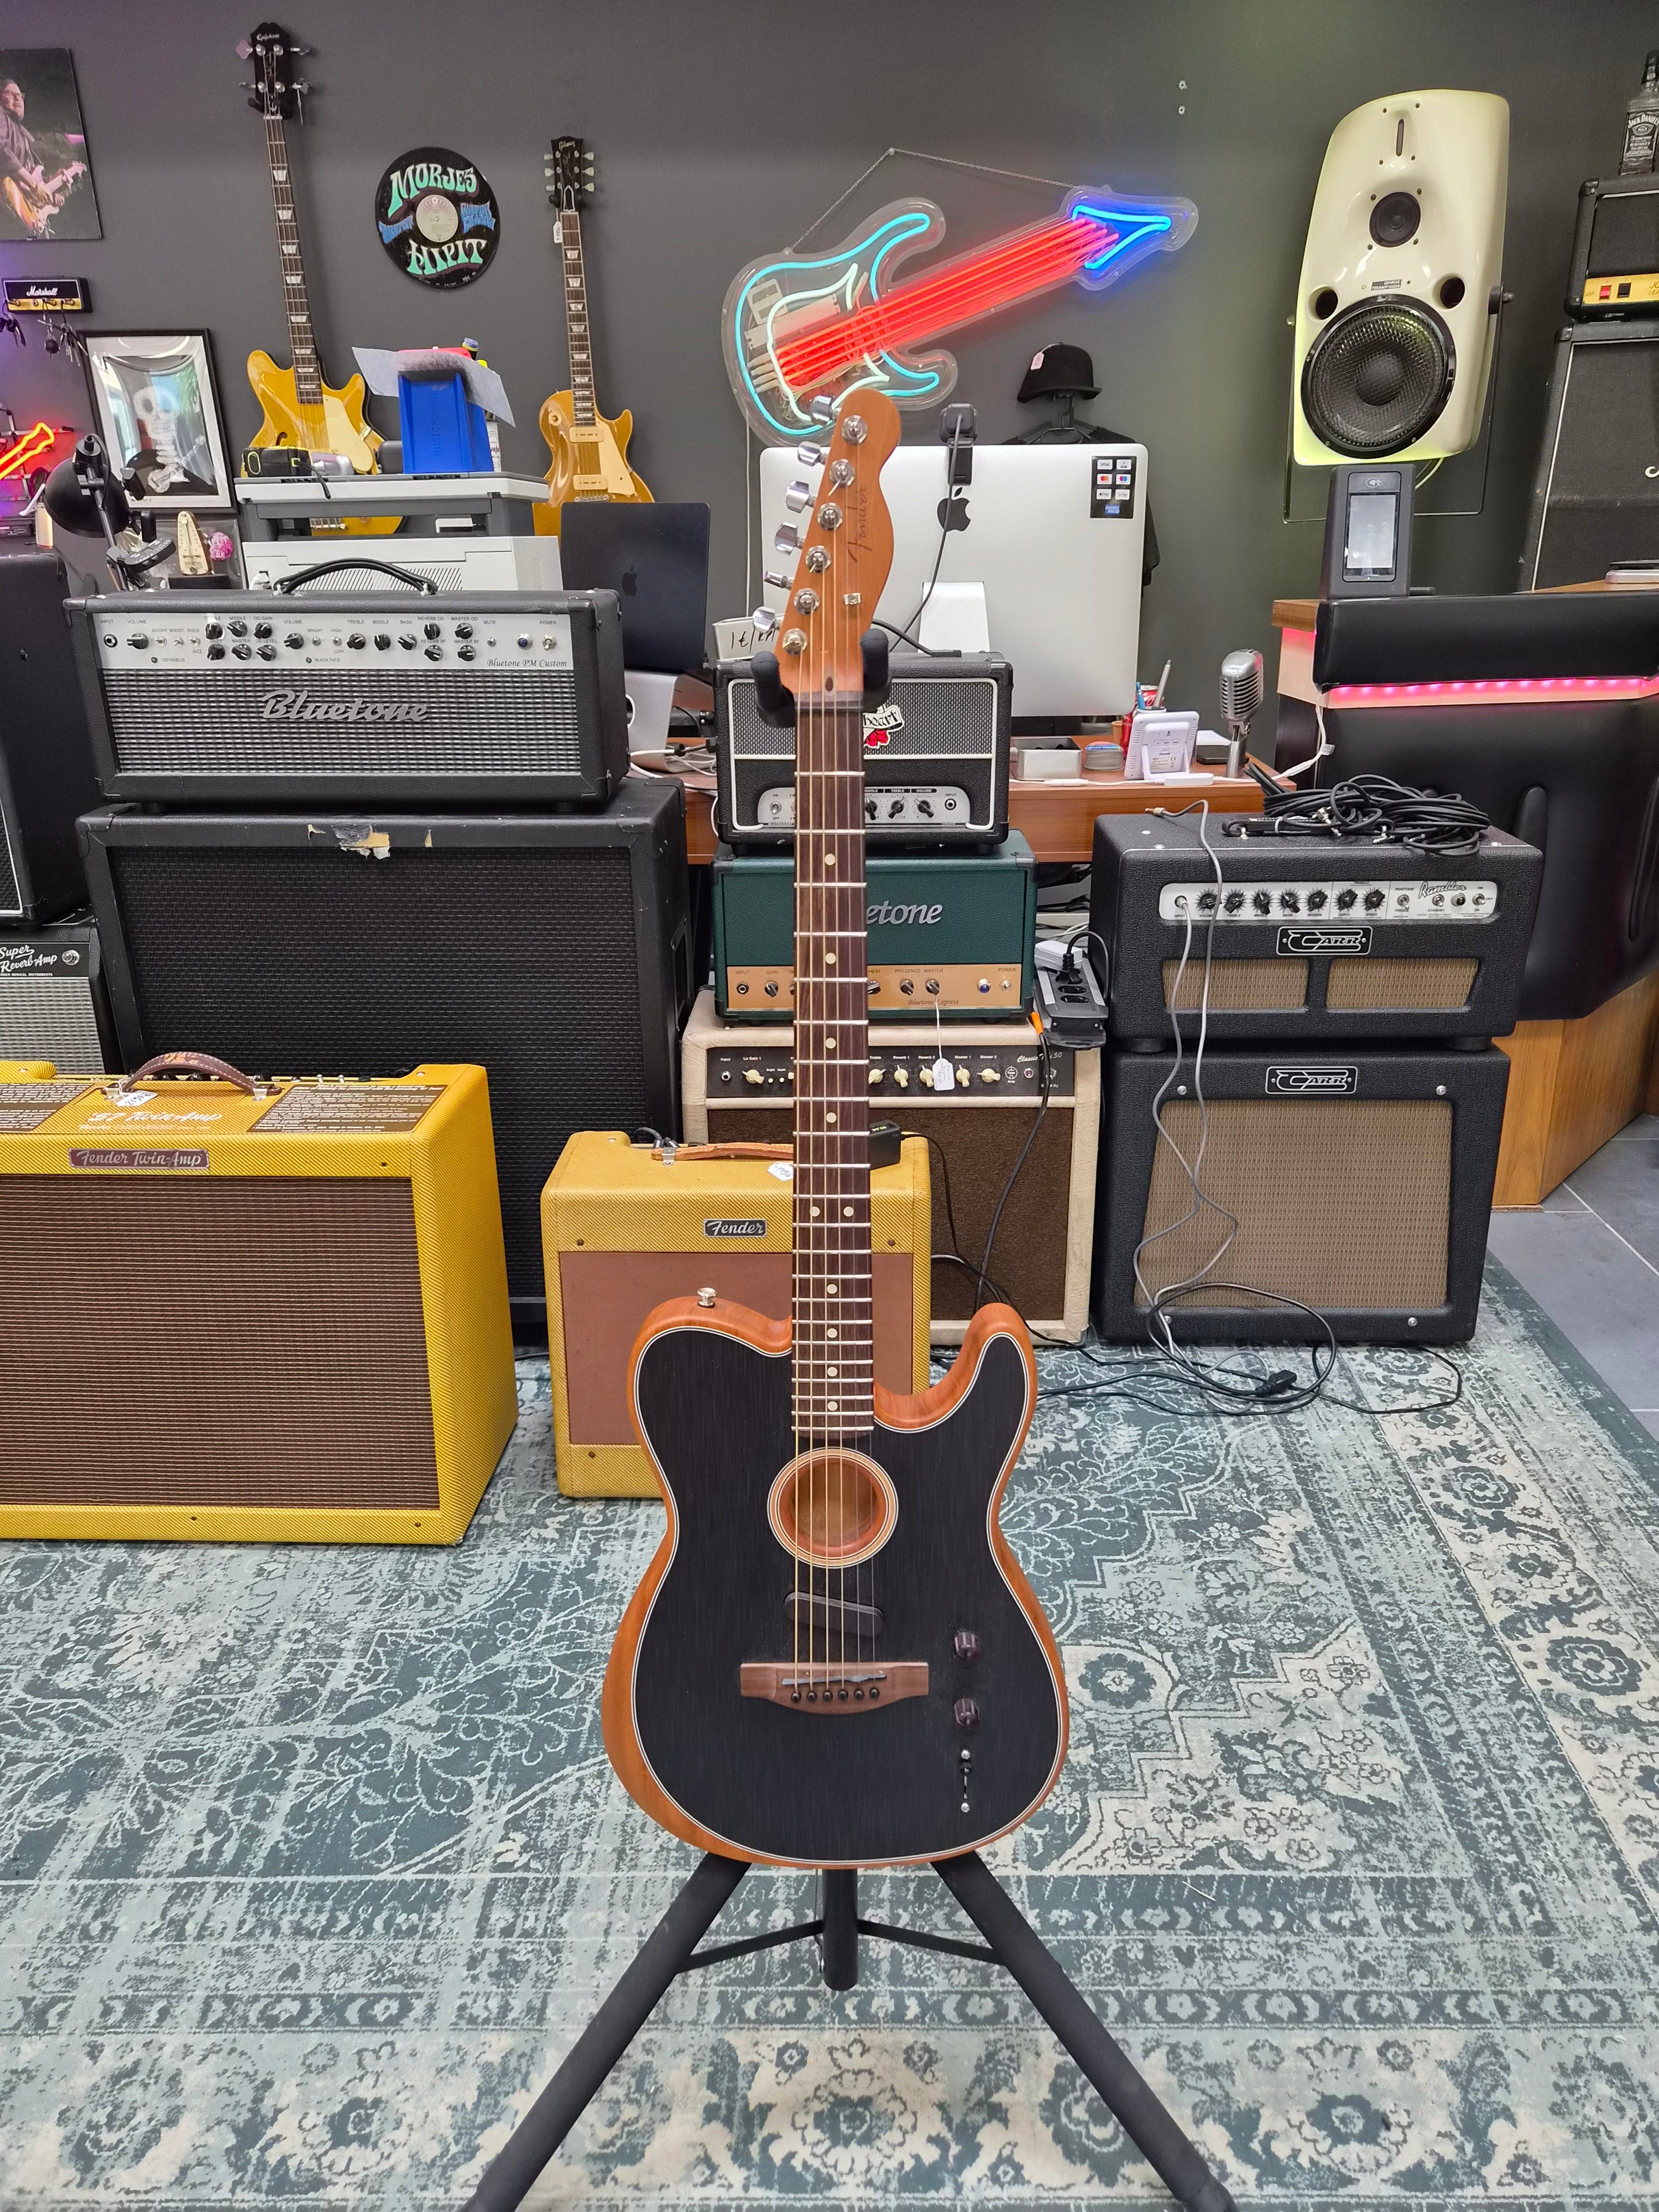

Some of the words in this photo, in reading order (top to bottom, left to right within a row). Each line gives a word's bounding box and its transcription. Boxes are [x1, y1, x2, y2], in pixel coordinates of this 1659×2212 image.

[388, 163, 477, 218] MORJES
[407, 239, 487, 275] HIPIT
[26, 285, 58, 296] Marshall
[844, 487, 873, 562] Fender
[487, 658, 520, 667] Bluetone
[521, 658, 537, 667] PM
[539, 658, 567, 667] Custom
[261, 690, 429, 721] Bluetone
[864, 710, 898, 726] heart
[1418, 881, 1467, 899] Rambler
[76, 1150, 128, 1166] Fender
[132, 1150, 202, 1167] Twin-Amp
[707, 1220, 764, 1235] Fender
